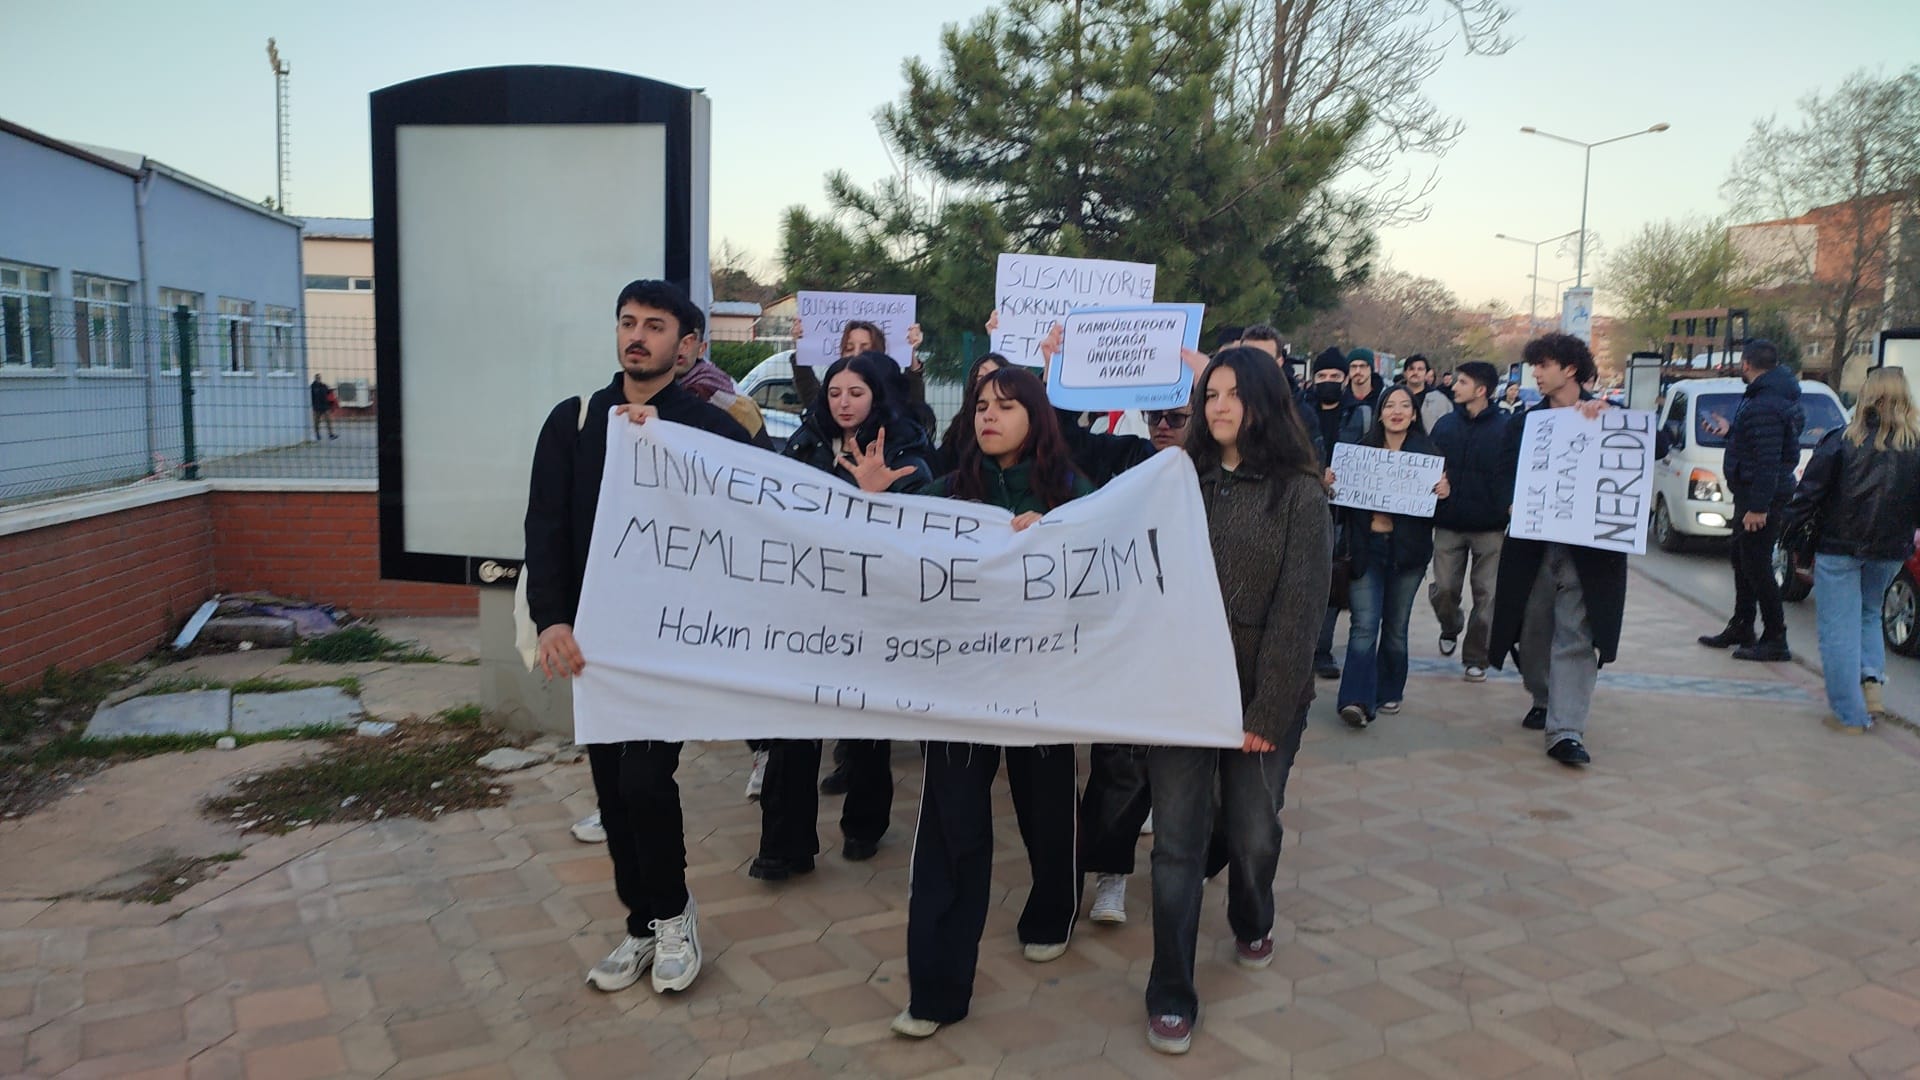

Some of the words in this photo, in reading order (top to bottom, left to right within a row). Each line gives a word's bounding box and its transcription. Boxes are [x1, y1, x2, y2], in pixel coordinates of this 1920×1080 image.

[1076, 317, 1177, 335] KAMPÜSLERDEN
[1594, 414, 1649, 548] NEREDE
[613, 516, 883, 597] MEMLEKET
[920, 557, 981, 602] DE
[658, 606, 750, 650] Halkın
[764, 624, 863, 656] iradesi
